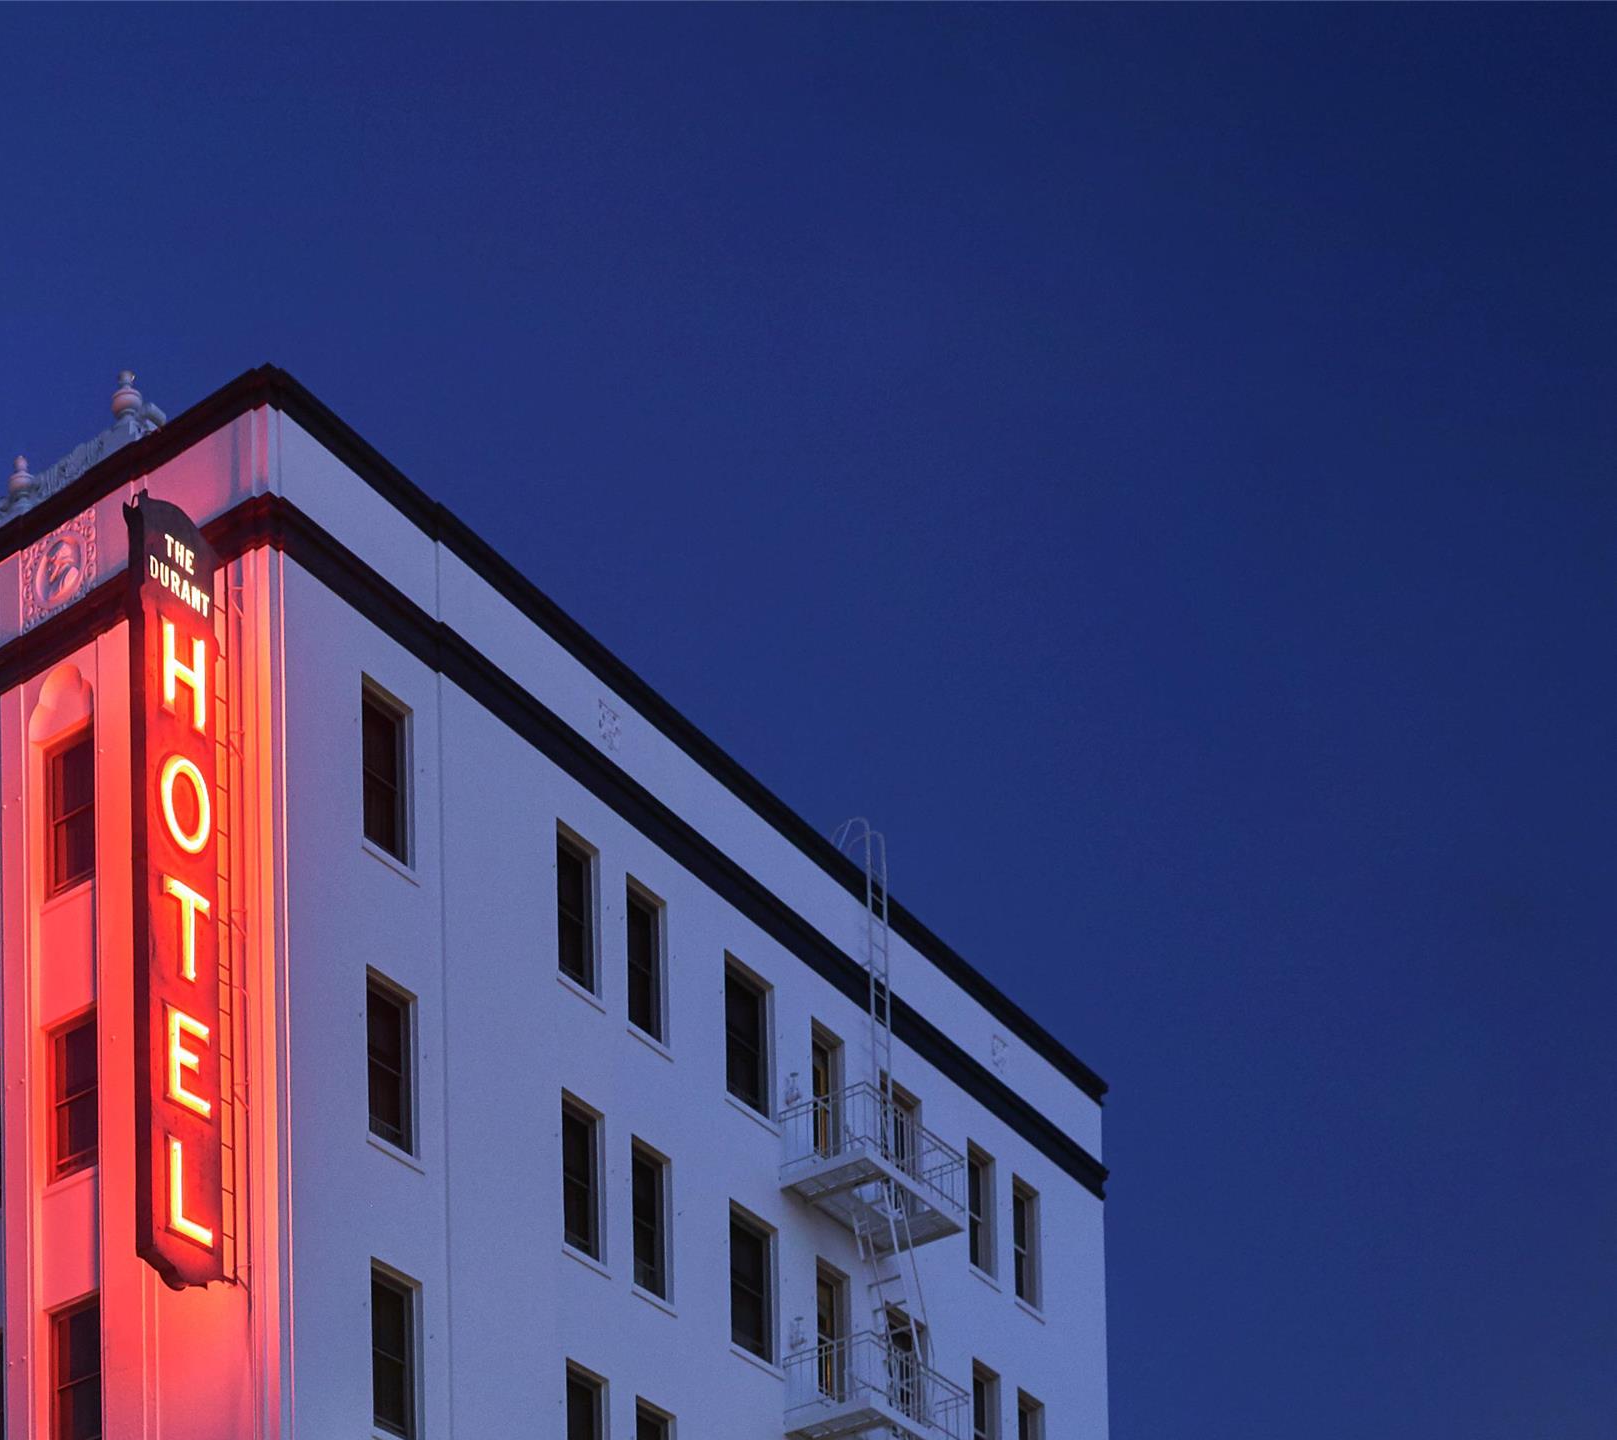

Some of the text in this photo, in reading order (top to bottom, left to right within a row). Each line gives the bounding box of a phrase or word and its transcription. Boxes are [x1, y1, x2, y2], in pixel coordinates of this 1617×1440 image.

[149, 554, 210, 618] DURANT
[164, 533, 195, 575] THE
[159, 615, 213, 1248] HOTEL
